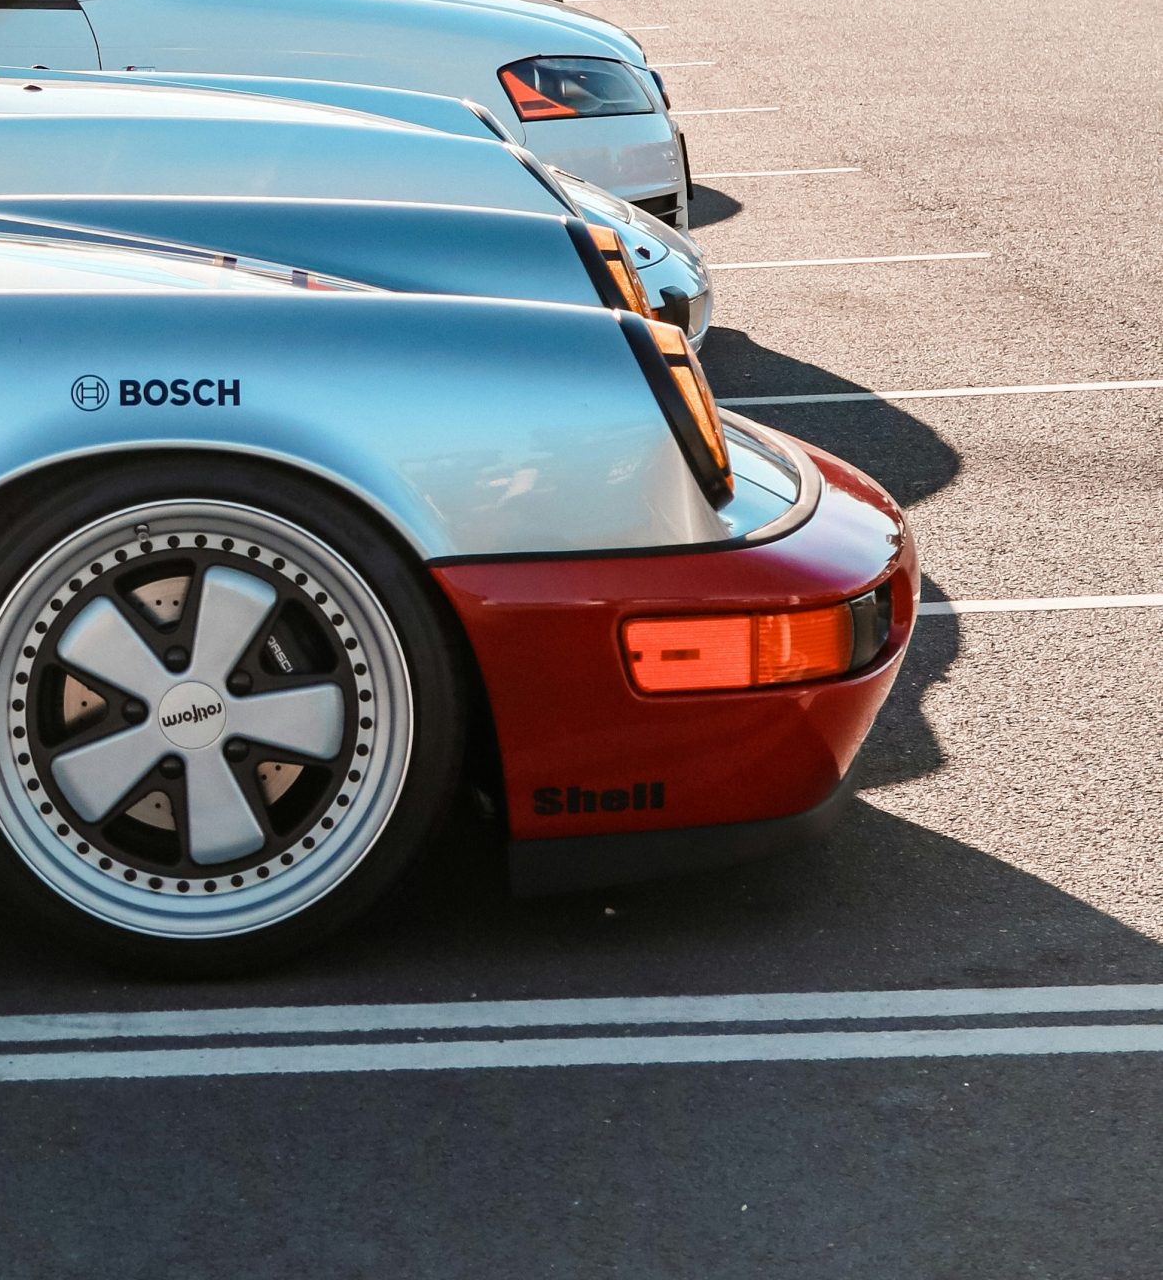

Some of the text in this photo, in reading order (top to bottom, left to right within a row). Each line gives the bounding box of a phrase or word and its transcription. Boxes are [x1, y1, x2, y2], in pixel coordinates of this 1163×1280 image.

[119, 378, 241, 407] BOSCH
[161, 702, 223, 728] rotiform
[533, 782, 665, 816] Shell
